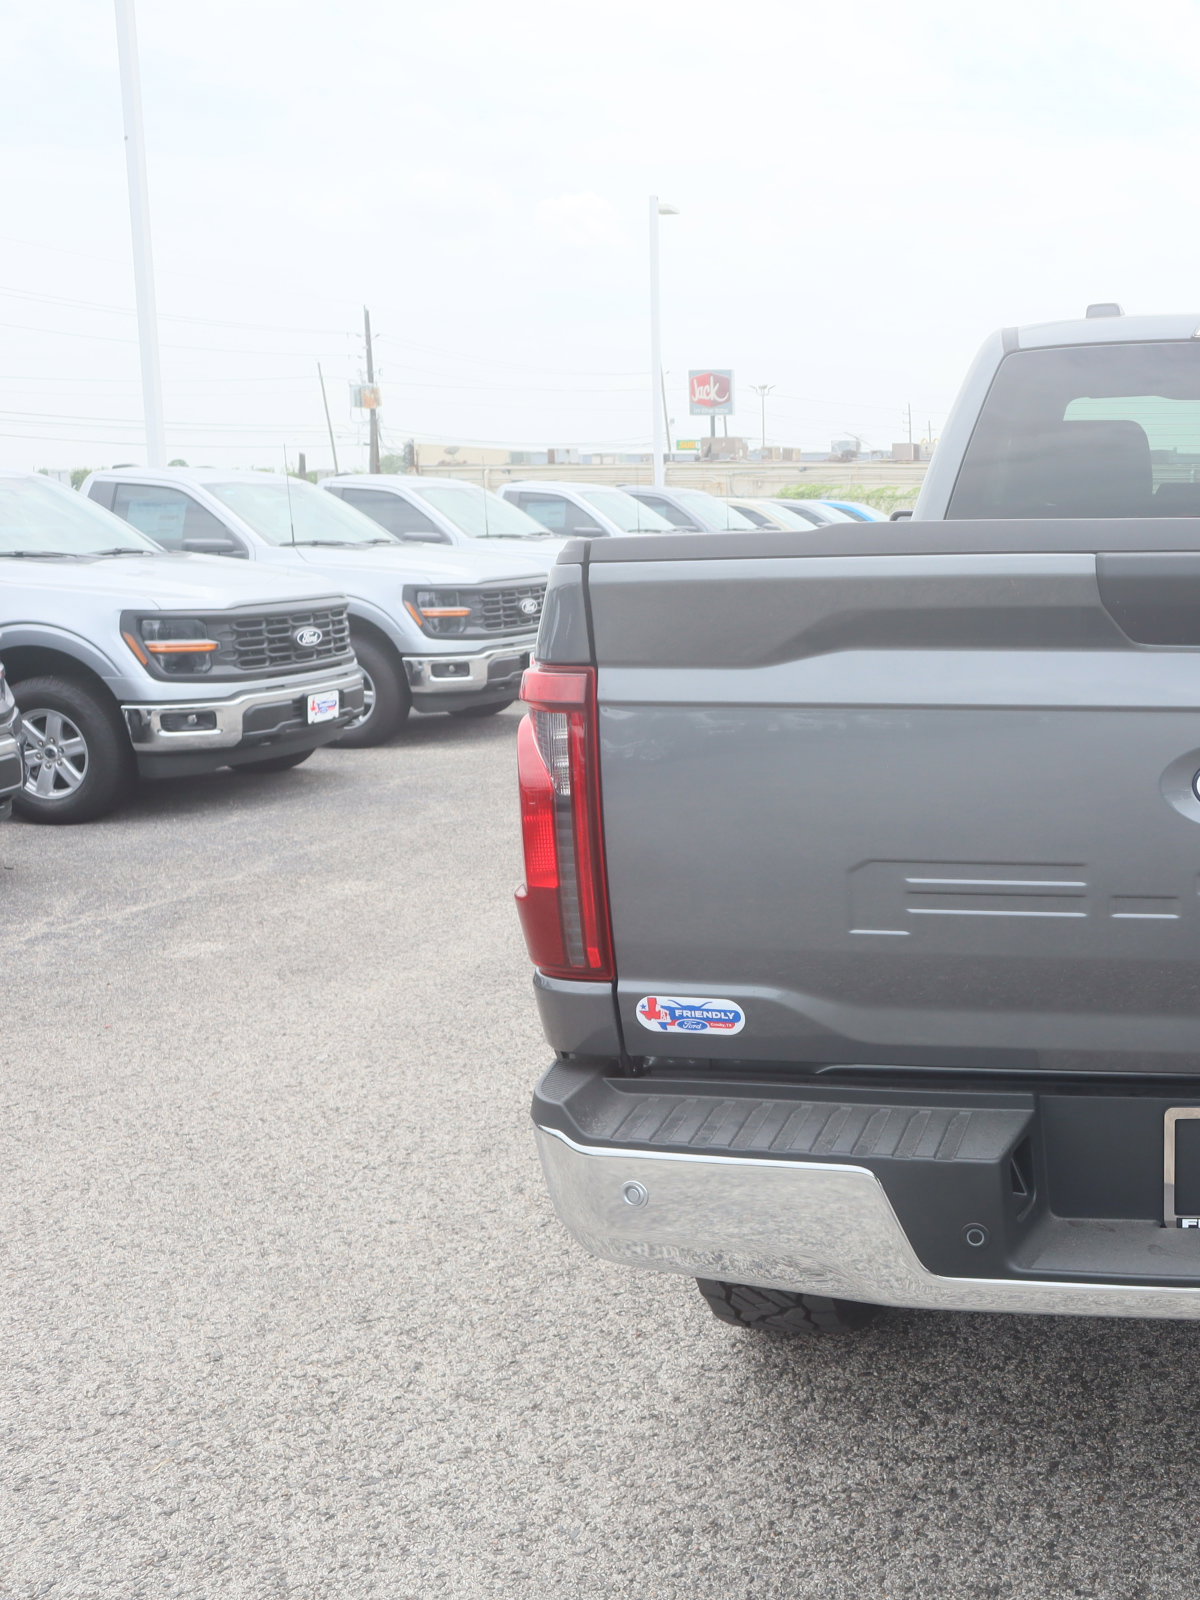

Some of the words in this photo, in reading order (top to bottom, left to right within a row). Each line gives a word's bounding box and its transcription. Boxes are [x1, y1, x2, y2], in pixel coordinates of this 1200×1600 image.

[691, 375, 730, 402] Jack
[674, 1009, 735, 1020] FRIENDLY
[682, 1021, 702, 1029] Ford
